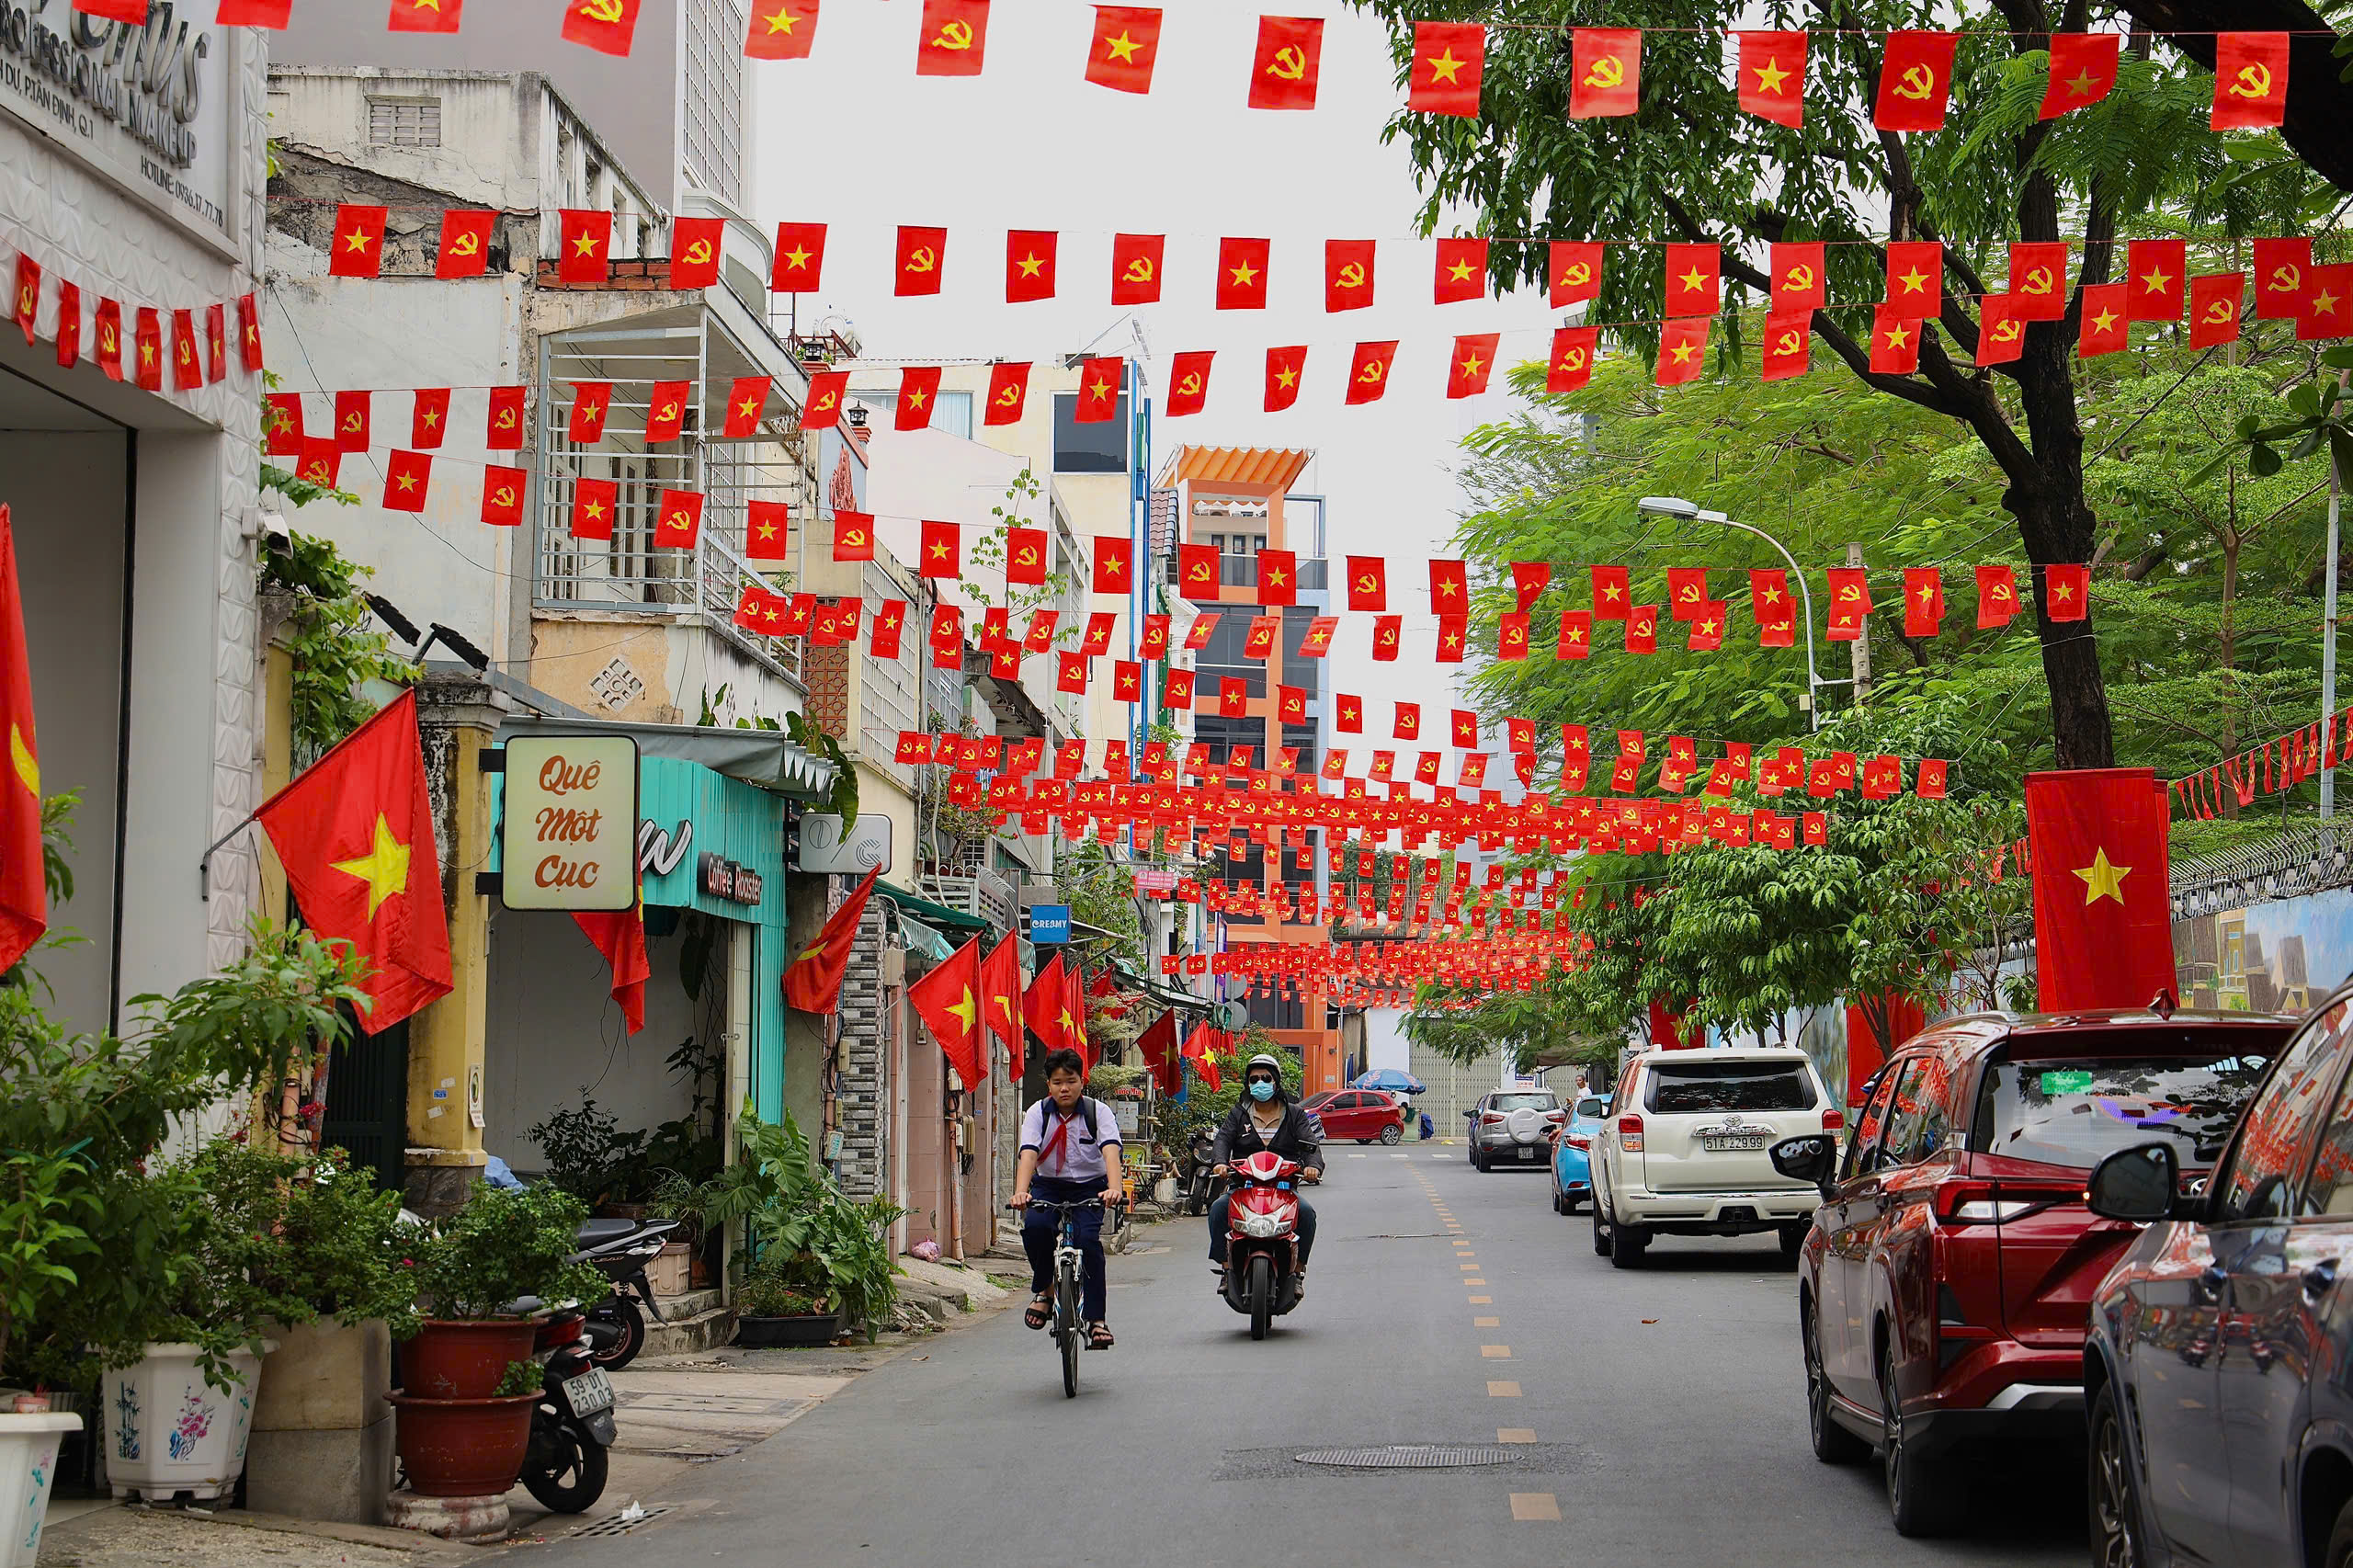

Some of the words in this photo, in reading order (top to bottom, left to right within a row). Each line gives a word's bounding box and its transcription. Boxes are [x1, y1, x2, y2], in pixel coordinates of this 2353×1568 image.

[539, 756, 601, 796] Quê
[535, 807, 603, 846] Một
[534, 855, 600, 892] Cục
[708, 856, 733, 895] Coffee
[1031, 919, 1067, 928] CREAMY
